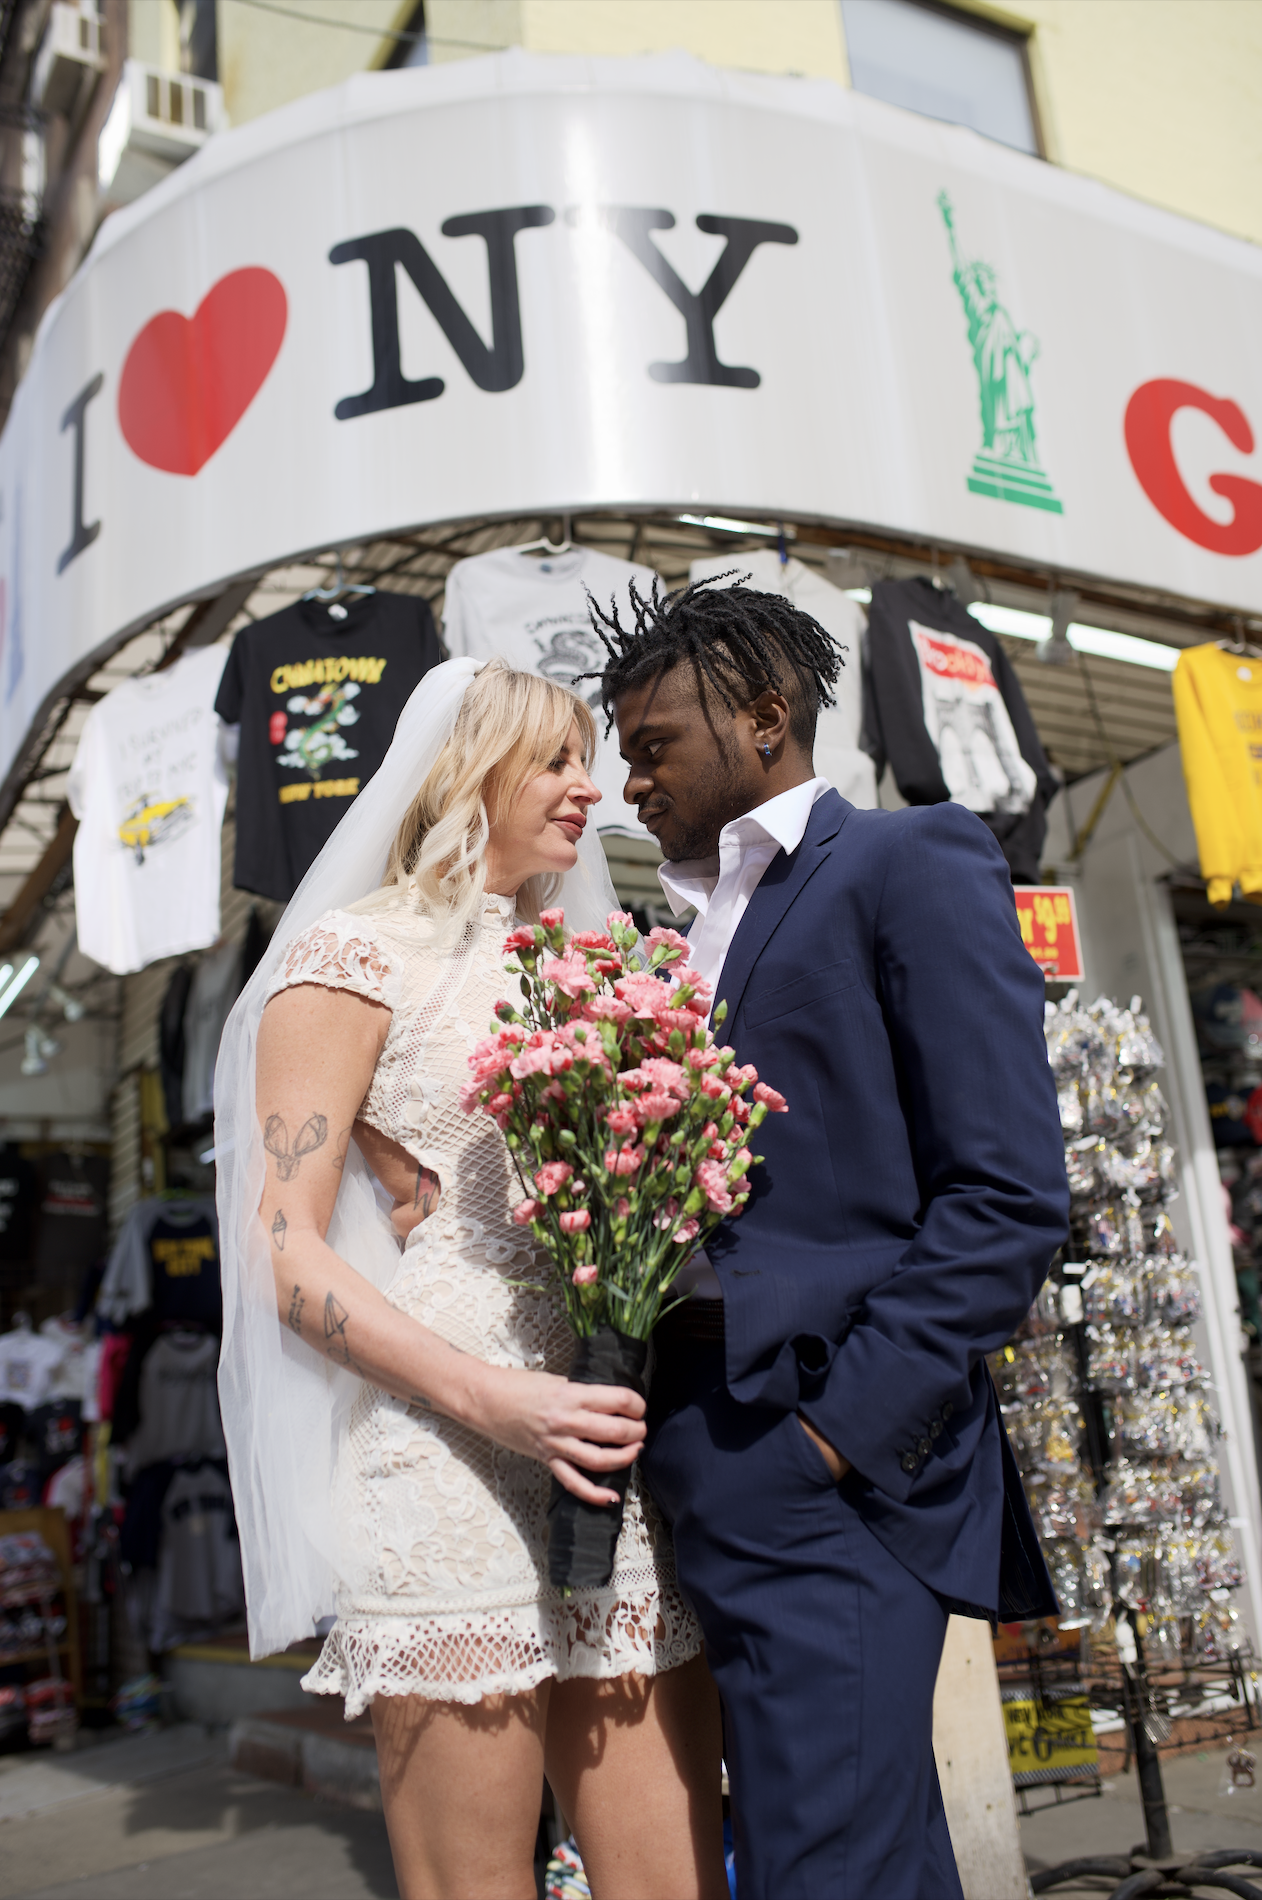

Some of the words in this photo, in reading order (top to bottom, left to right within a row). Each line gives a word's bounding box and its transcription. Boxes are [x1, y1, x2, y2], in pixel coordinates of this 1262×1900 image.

[57, 371, 104, 577] I
[328, 203, 800, 421] NY
[270, 656, 387, 694] CHINATOWN
